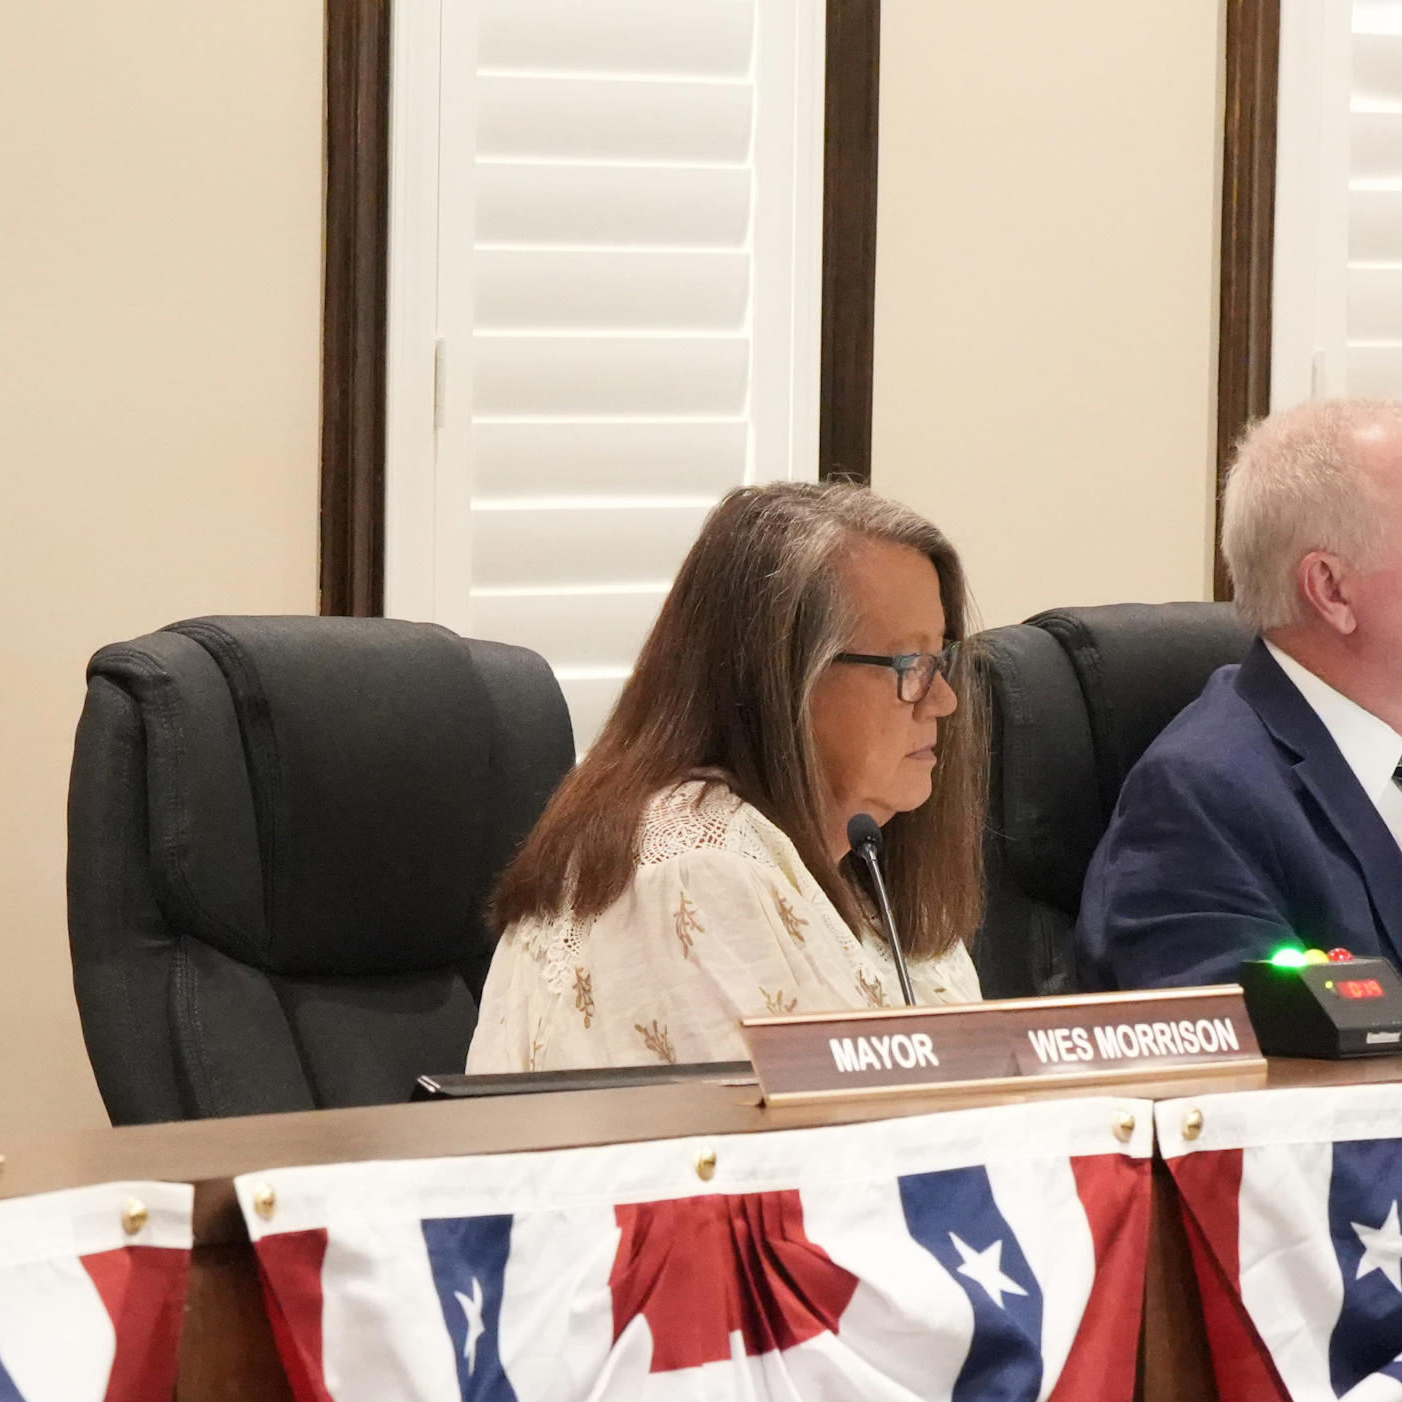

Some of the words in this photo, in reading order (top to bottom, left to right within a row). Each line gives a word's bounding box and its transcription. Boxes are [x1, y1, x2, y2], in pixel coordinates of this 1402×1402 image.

[828, 1032, 940, 1073] MAYOR
[1028, 1026, 1095, 1064] WES
[1092, 1017, 1240, 1059] MORRISON
